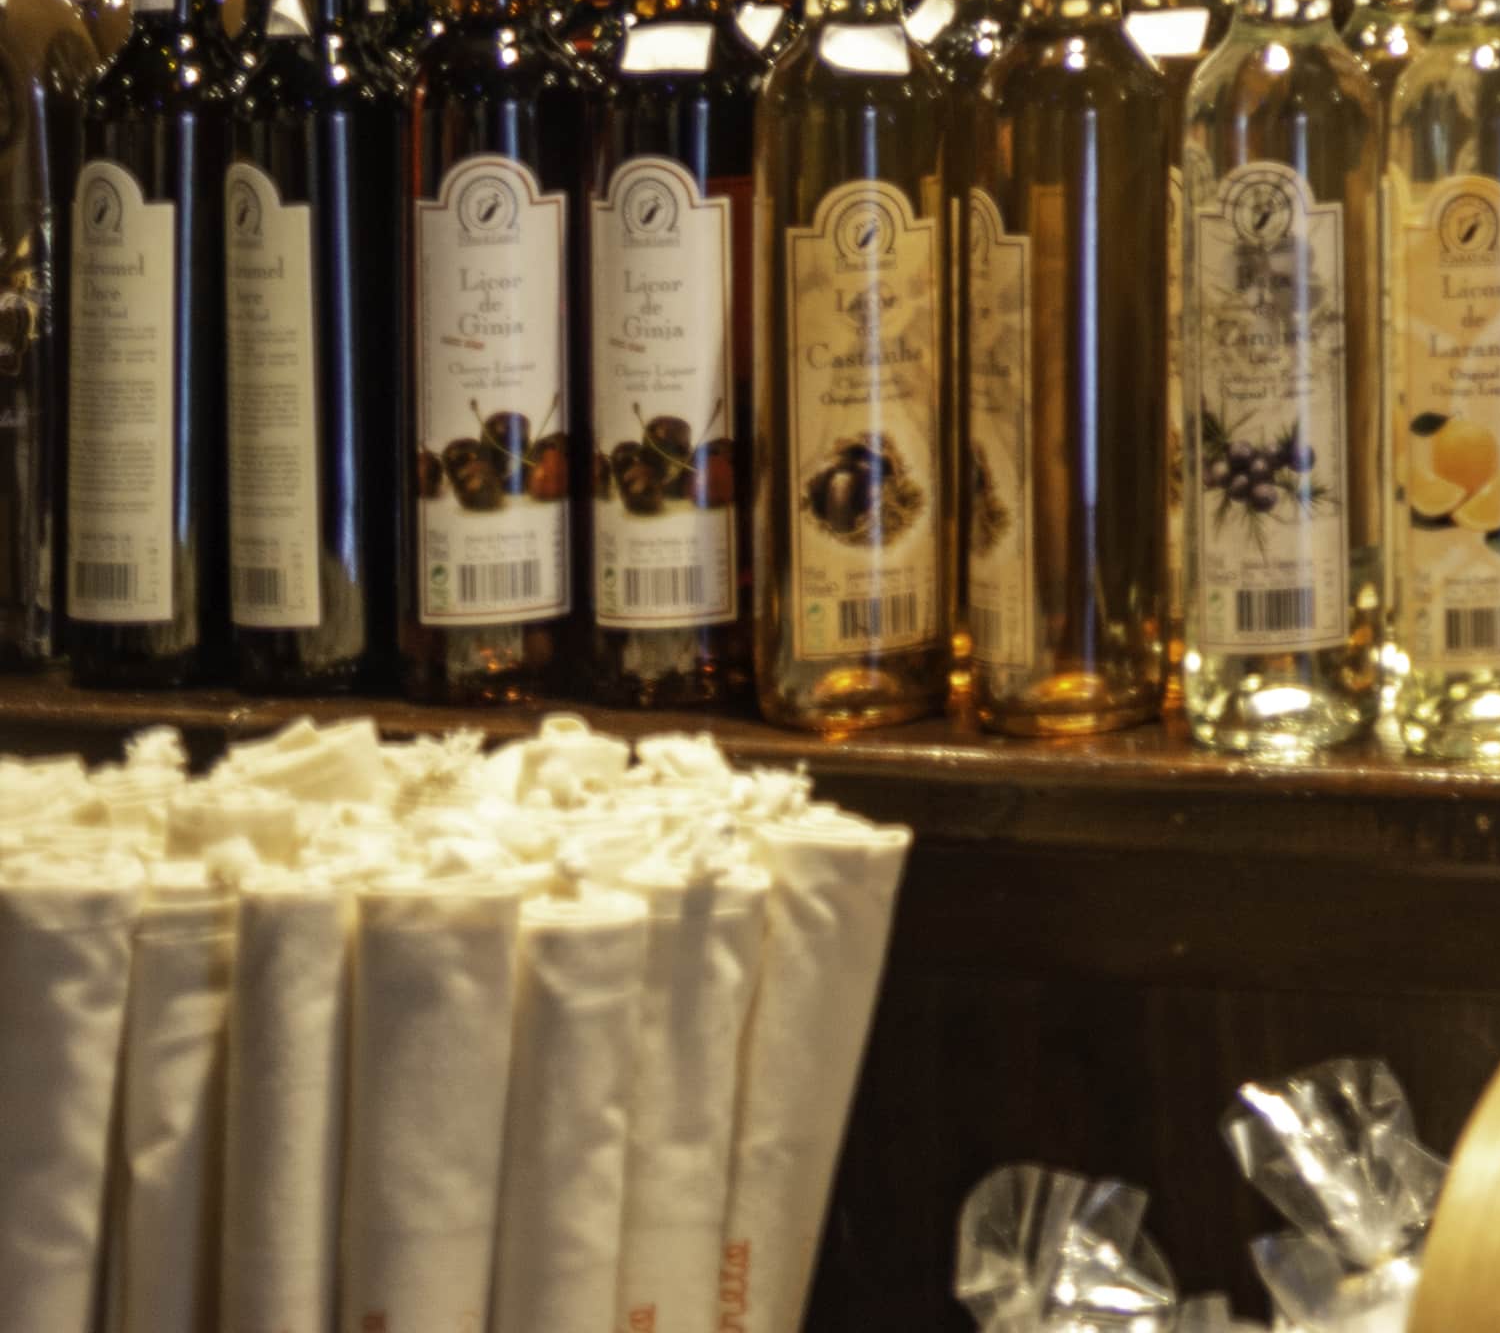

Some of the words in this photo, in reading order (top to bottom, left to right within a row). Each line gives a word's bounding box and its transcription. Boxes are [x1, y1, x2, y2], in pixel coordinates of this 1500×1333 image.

[458, 267, 524, 293] Licor
[622, 269, 685, 295] Licor
[457, 313, 525, 343] Ginja
[621, 315, 685, 344] Ginja
